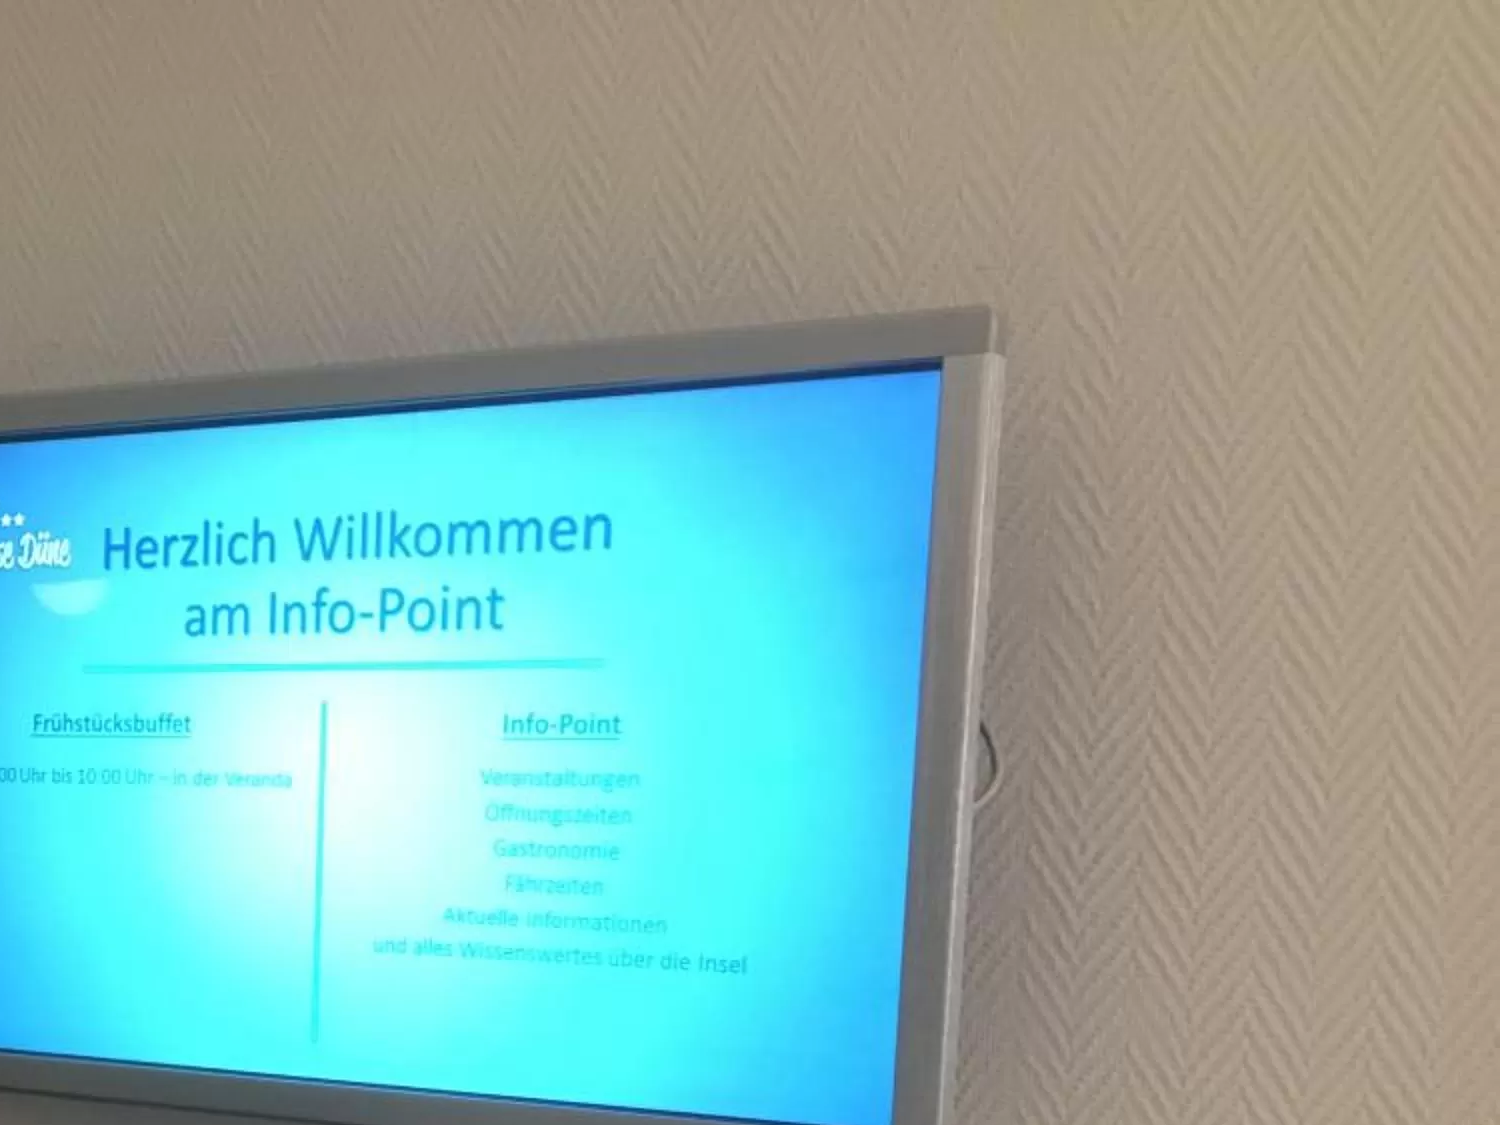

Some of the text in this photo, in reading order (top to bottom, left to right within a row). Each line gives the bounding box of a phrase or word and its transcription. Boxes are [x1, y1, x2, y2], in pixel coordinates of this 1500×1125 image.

[18, 531, 72, 569] Düne
[102, 508, 614, 571] Herzlich Willkommen
[183, 584, 505, 638] am Info-Point
[30, 712, 193, 737] Frühstücksbuffet
[501, 712, 624, 737] Info-Point
[19, 766, 47, 785] Uhr
[51, 766, 73, 785] bis
[124, 767, 154, 786] Uhr
[173, 768, 188, 787] in
[192, 769, 219, 788] der
[223, 770, 293, 789] Veranda
[480, 768, 641, 793] Veranstaltungen
[492, 838, 621, 862] Gastronomie
[443, 906, 669, 935] Aktuelle Informationen
[372, 938, 408, 956] und
[412, 937, 454, 958] alles
[458, 939, 601, 967] Wissenswertes
[660, 950, 691, 972] die
[699, 951, 748, 976] Insel
